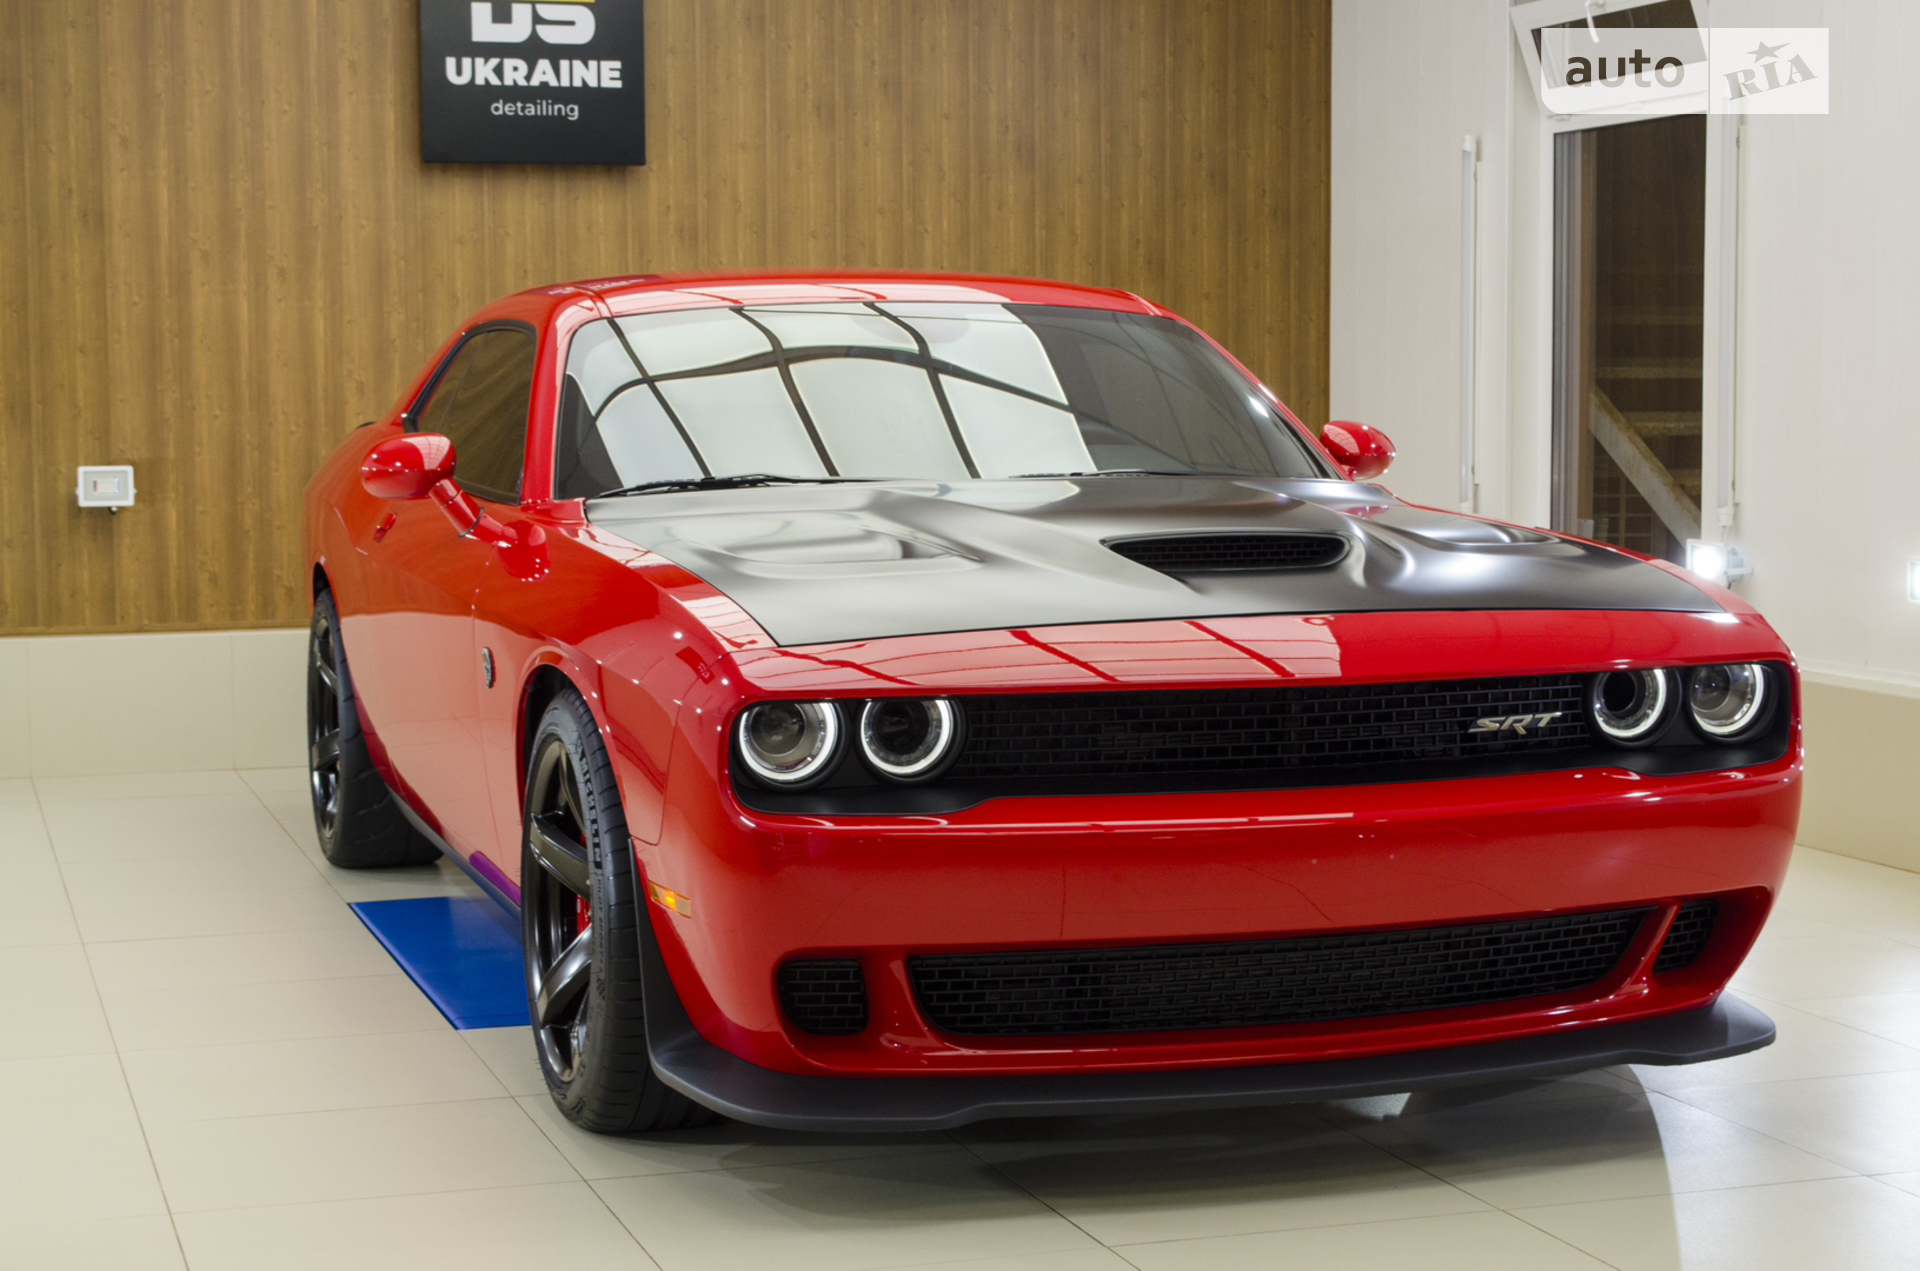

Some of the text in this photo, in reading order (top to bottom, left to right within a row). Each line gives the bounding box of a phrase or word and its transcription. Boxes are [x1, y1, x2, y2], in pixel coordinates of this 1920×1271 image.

[445, 56, 623, 88] UKRAINE
[490, 99, 580, 121] detailing
[1468, 711, 1563, 735] SRT
[580, 757, 602, 862] MICHELIN
